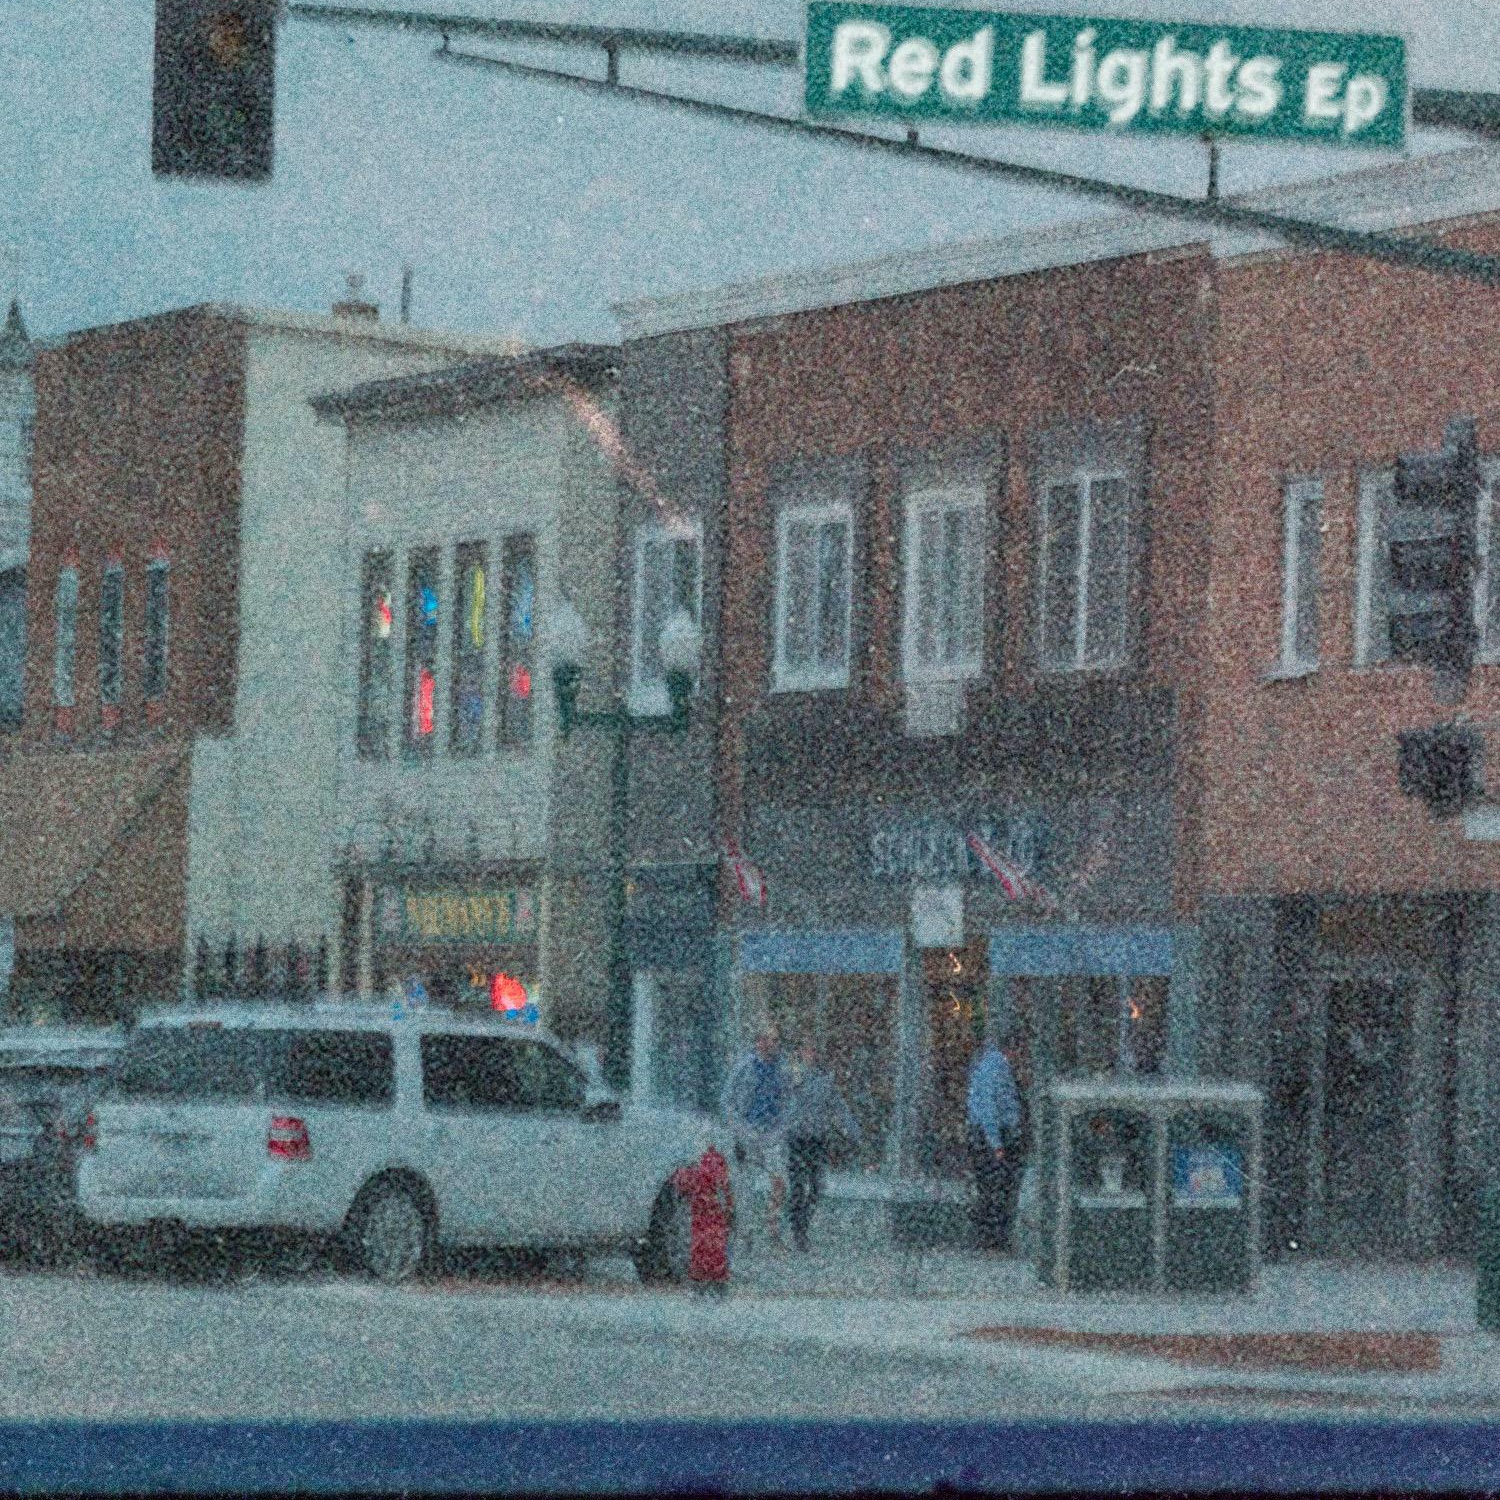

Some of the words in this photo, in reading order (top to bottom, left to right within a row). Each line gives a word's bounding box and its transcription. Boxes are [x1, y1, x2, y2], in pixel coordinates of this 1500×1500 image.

[831, 19, 993, 104] Red
[1019, 26, 1284, 127] Lights
[1303, 61, 1387, 135] Ep
